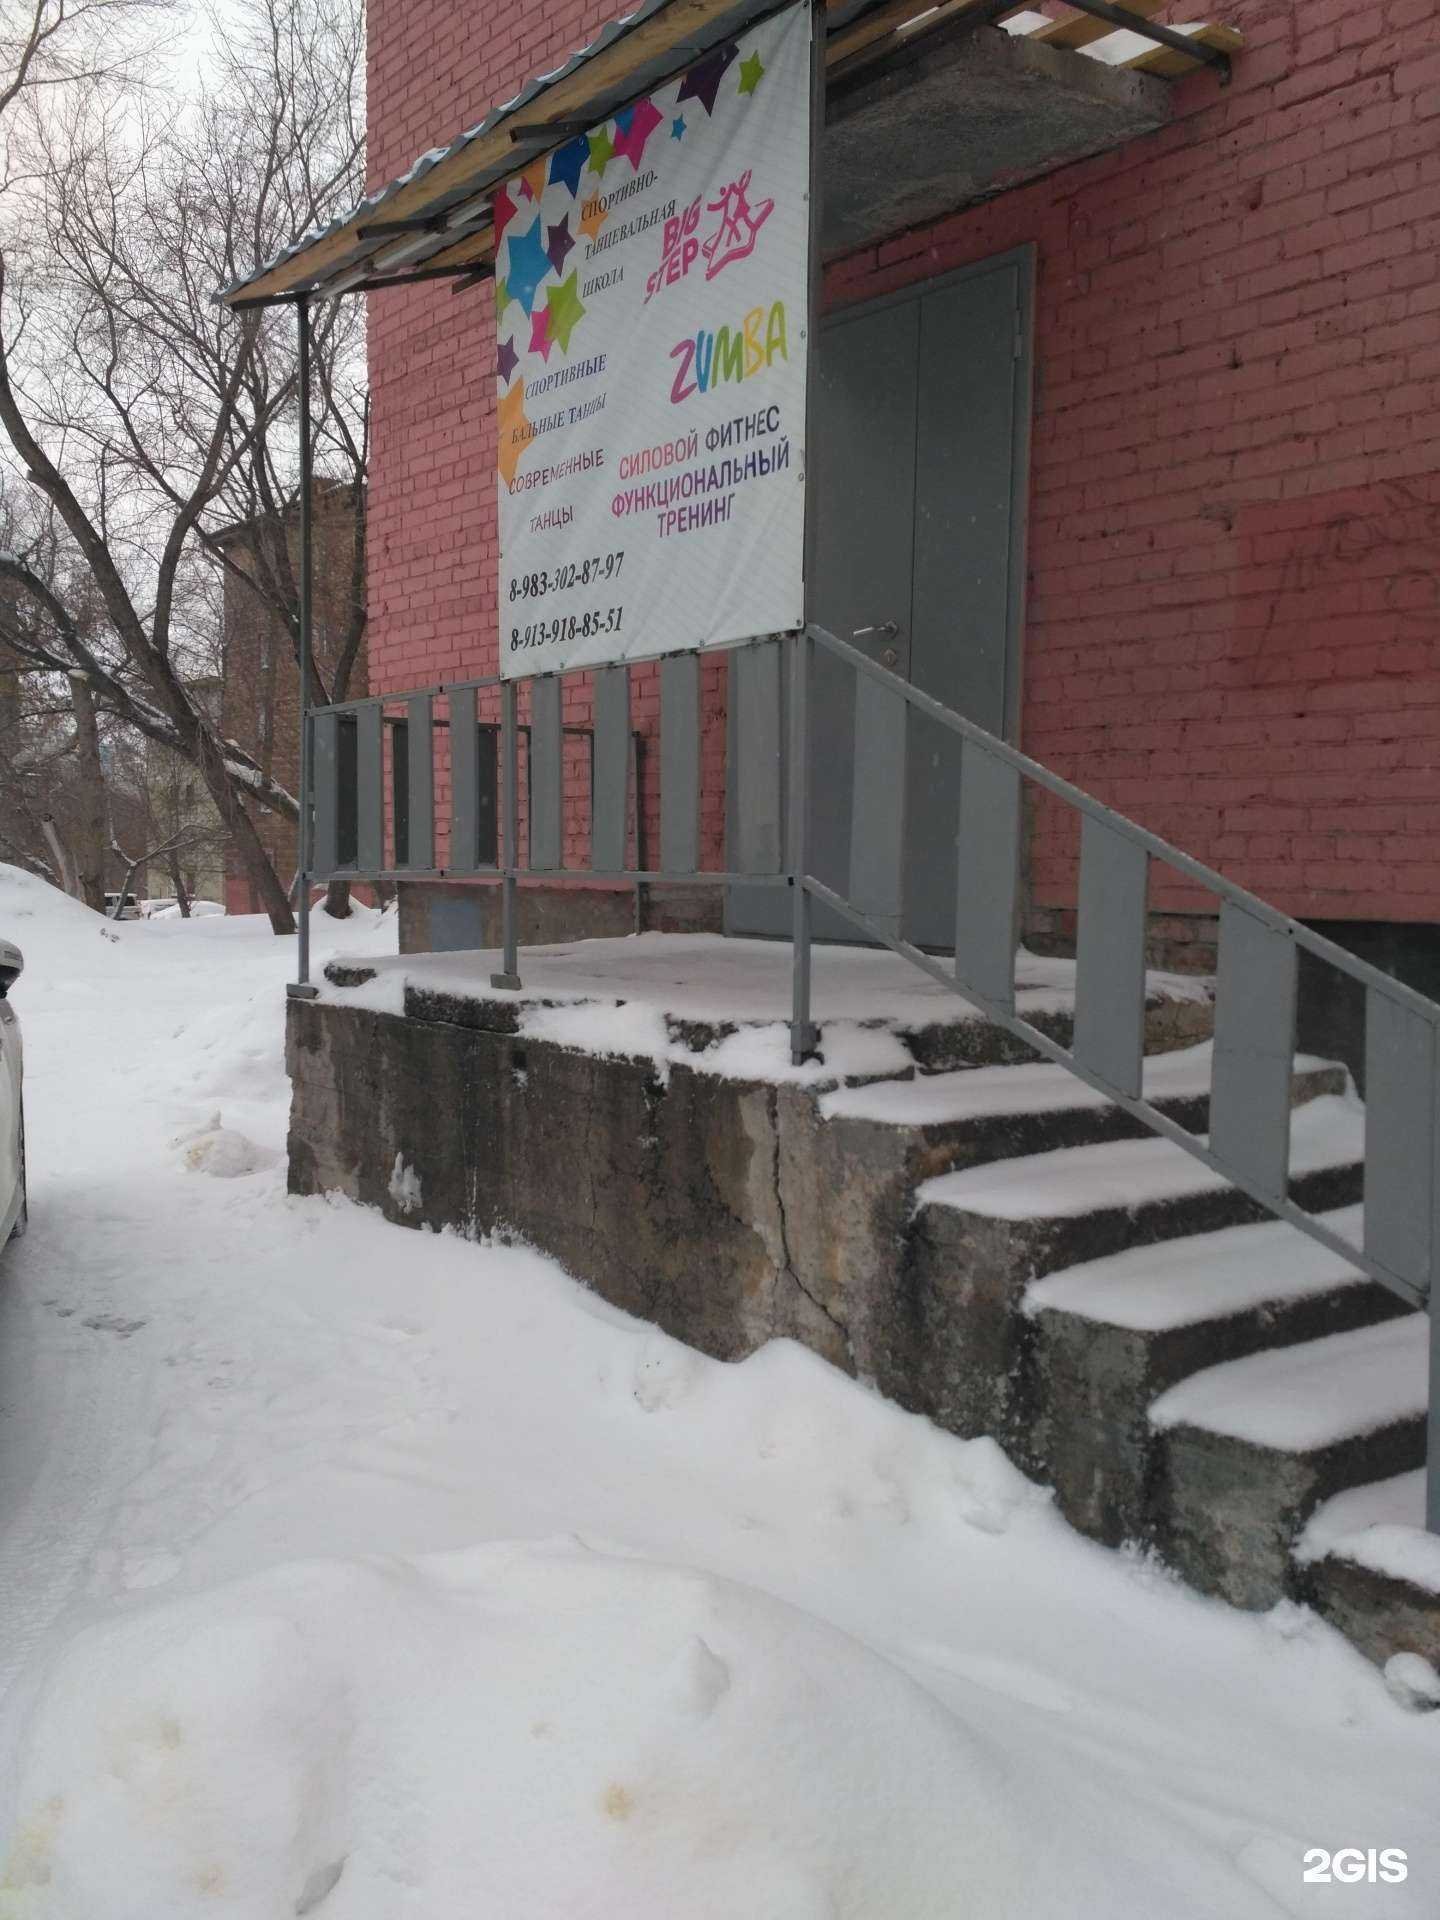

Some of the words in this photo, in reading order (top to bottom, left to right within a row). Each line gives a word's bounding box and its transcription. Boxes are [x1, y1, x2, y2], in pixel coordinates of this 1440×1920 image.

[581, 169, 658, 222] СПОРТИВНО-
[584, 199, 676, 260] ТАНЦЕВАЛЬНАЯ
[662, 193, 702, 257] BIG
[582, 265, 624, 298] ШКОЛА
[643, 236, 699, 305] STEP
[525, 353, 607, 400] СПОРТИВНЫЕ
[669, 301, 788, 404] ZUMBA
[511, 411, 565, 444] БАЛЬНЫЕ
[569, 392, 607, 424] ТАНЦЫ
[619, 427, 699, 481] СИЛОВОЙ
[705, 404, 780, 453] ФИТНЕС
[508, 448, 605, 496] СОВРЕМЕННЫЕ
[611, 434, 790, 518] ФУНКЦИОНАЛЬНЫЙ
[529, 505, 574, 534] ТАНЦЫ
[657, 493, 736, 538] ТРЕНИНГ
[509, 551, 625, 602] 8-983-302-87-97
[510, 606, 624, 652] 8-913-918-85-51
